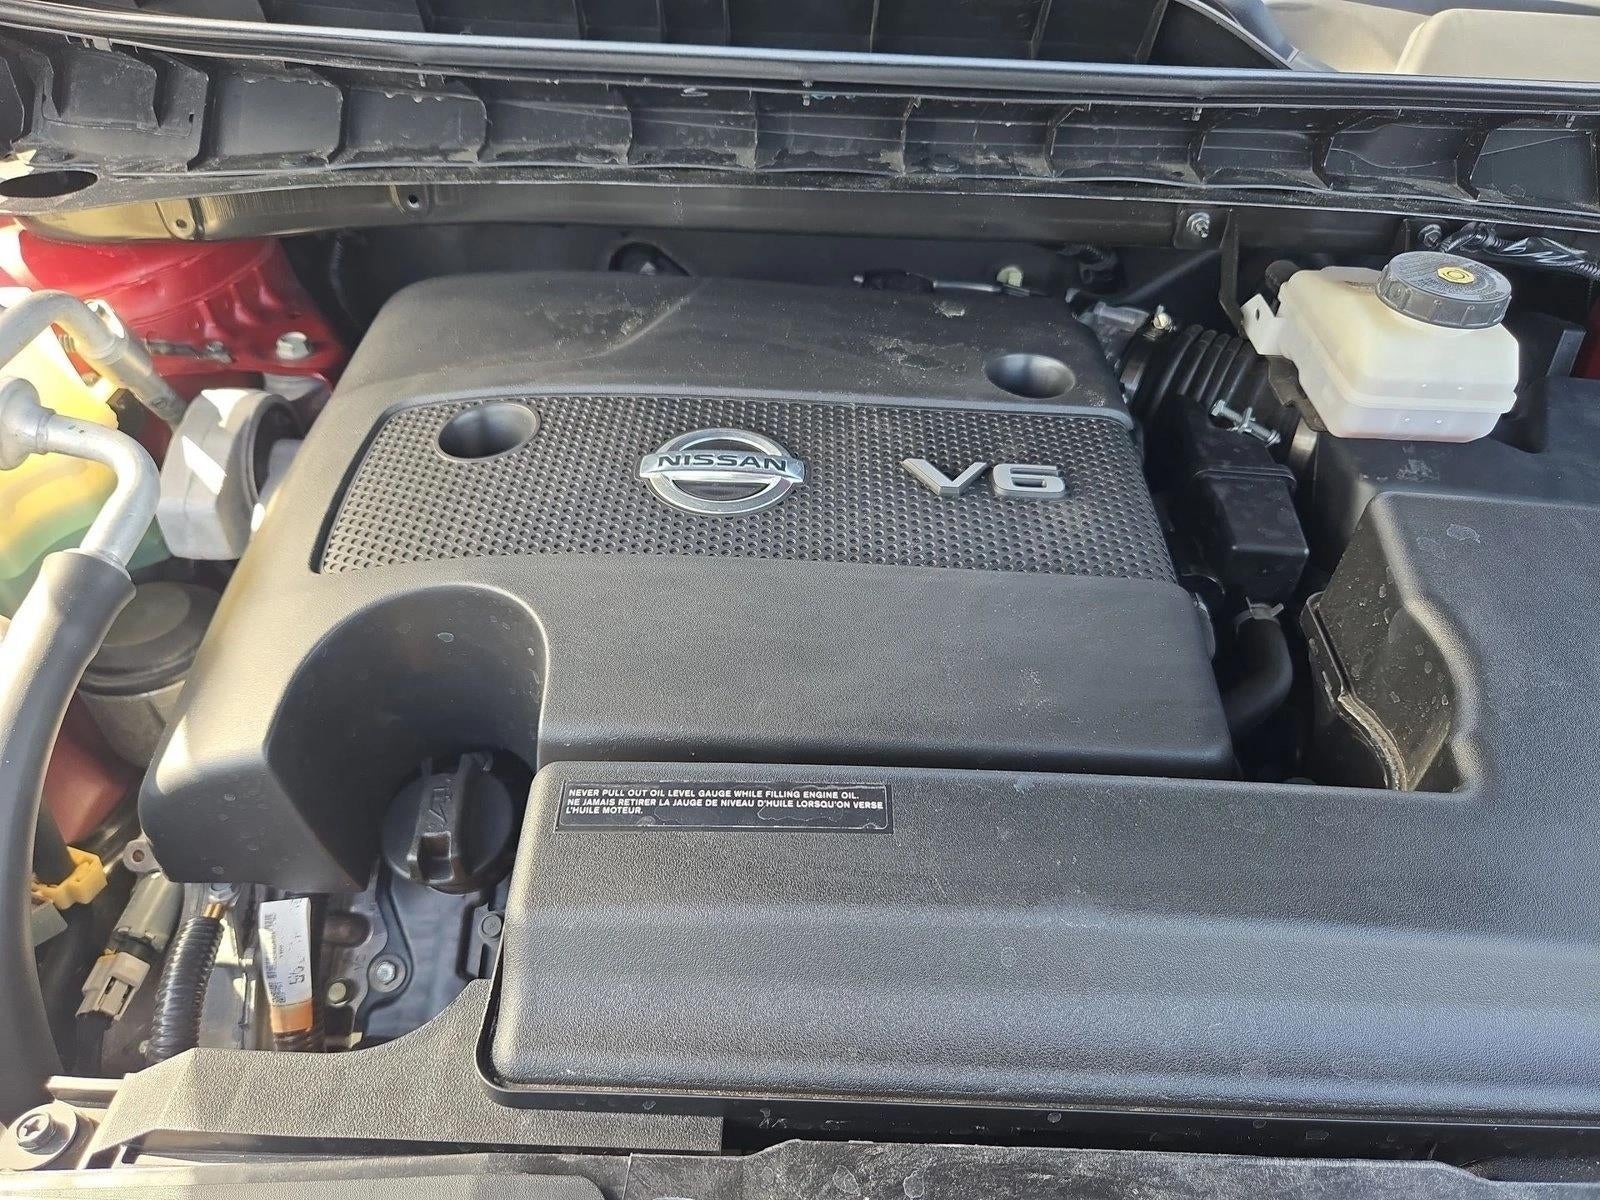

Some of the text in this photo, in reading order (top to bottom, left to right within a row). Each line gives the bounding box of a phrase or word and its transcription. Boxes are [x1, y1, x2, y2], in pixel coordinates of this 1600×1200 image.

[657, 454, 788, 472] NISSAN
[900, 458, 1066, 498] V6
[568, 789, 859, 799] NEVER PULL OUT OIL LEVEL GAUGE WHILE FILLING ENGINE OIL.
[565, 806, 643, 814] L'HUILE MOTEUR.
[567, 798, 884, 810] NE JAMAIS RETIRER LA JAUGE DE NIVEAU D'HUILE LORSQU'ON VERSE
